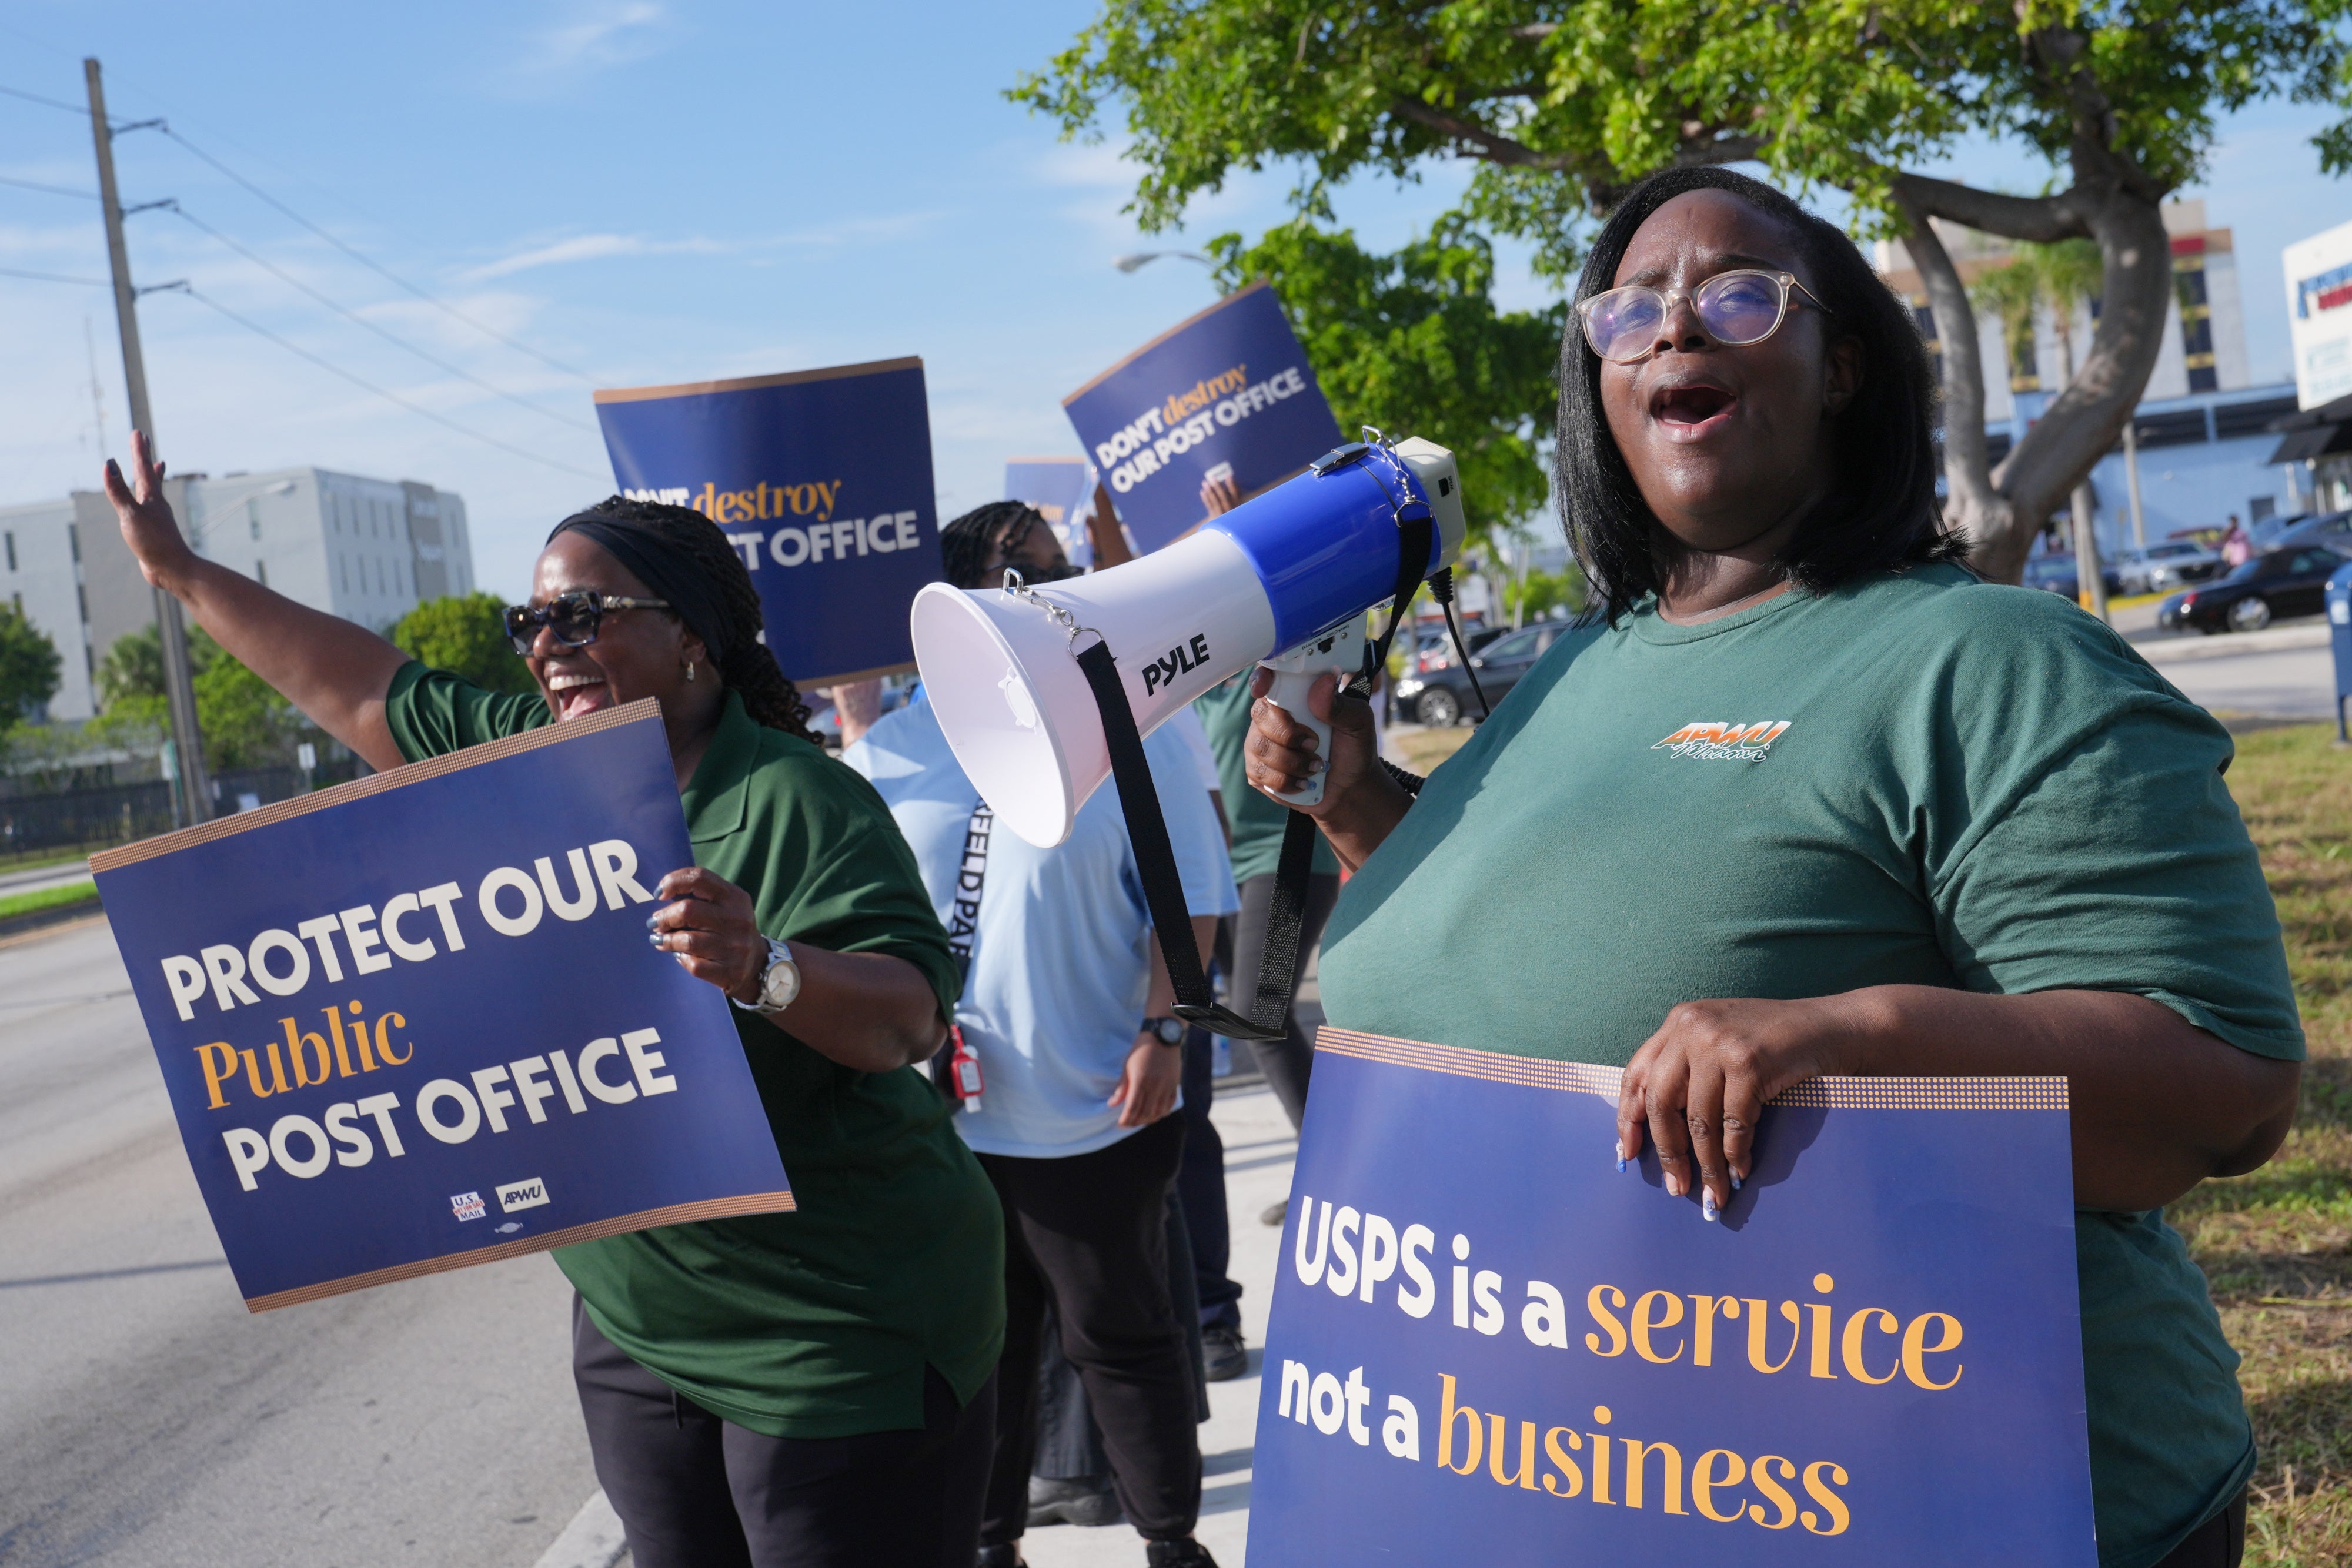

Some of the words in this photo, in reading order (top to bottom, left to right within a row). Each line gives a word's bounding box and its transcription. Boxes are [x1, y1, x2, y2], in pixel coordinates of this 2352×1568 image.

[1096, 407, 1164, 469] DON'T
[1163, 363, 1247, 426] destroy
[1111, 449, 1162, 493] OUR
[1154, 410, 1216, 464] POST
[1214, 366, 1307, 427] OFFICE
[693, 479, 842, 524] destroy
[770, 510, 921, 567] OFFICE
[1142, 633, 1210, 697] PYLE
[1651, 721, 1792, 750] APWU
[162, 881, 466, 1021] PROTECT
[478, 839, 655, 937] OUR
[194, 999, 413, 1110] Public
[222, 1092, 405, 1192] POST
[416, 1027, 677, 1144] OFFICE
[455, 1195, 477, 1206] U.S.
[460, 1210, 483, 1219] MAIL
[504, 1185, 541, 1205] APWU
[1295, 1195, 1435, 1319] USPS
[1452, 1233, 1505, 1336] is
[1521, 1280, 1568, 1349] a
[1585, 1273, 1963, 1390] service
[1278, 1359, 1371, 1446] not
[1382, 1394, 1420, 1462] a
[1437, 1372, 1850, 1536] business
